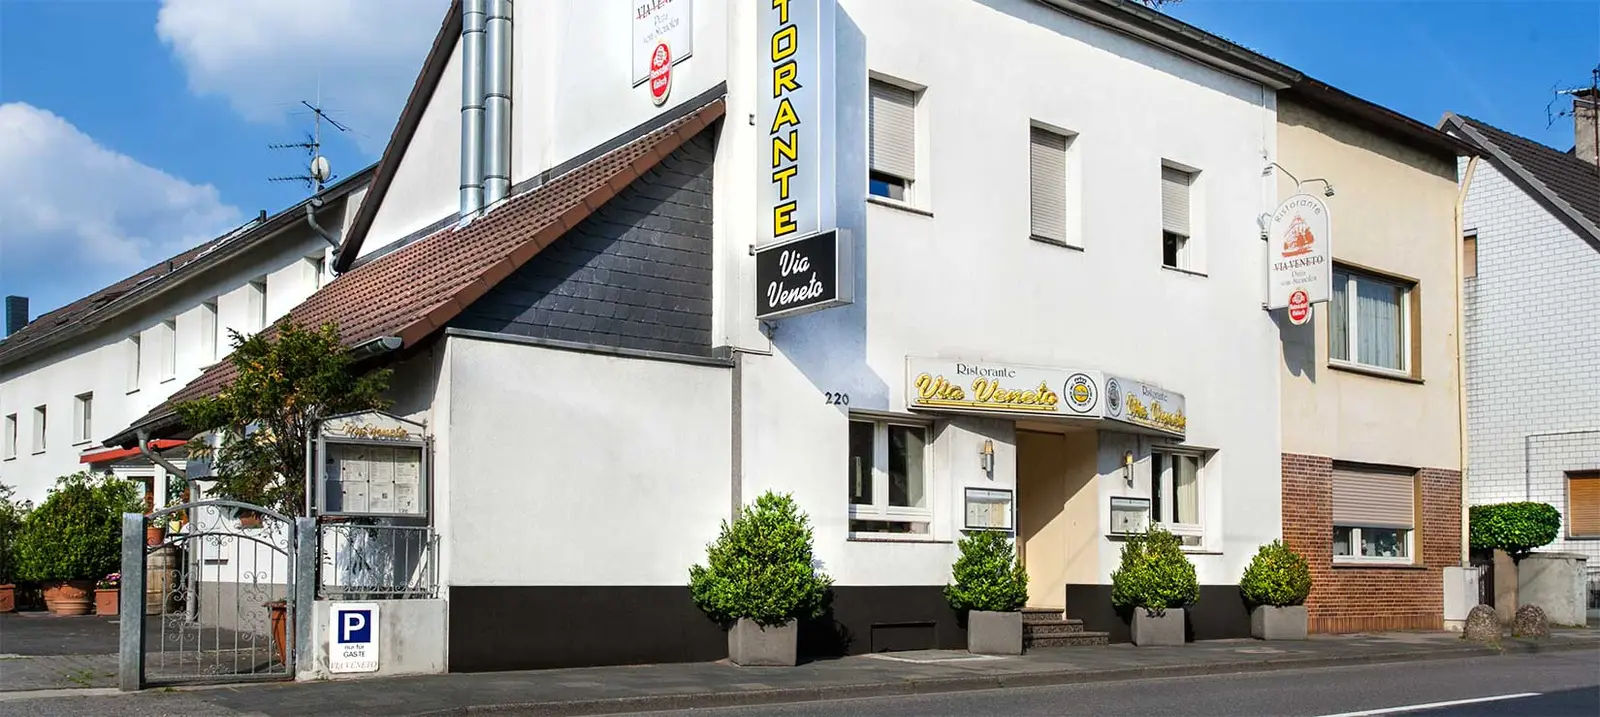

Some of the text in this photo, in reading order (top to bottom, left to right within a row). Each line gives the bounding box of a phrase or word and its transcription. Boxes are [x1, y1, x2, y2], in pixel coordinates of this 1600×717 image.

[1274, 199, 1321, 223] Ristorante
[779, 250, 810, 277] Via
[1273, 255, 1324, 271] VIA VENETO
[767, 272, 823, 307] Veneto
[956, 363, 1016, 378] Ristorante
[825, 391, 849, 406] 220
[915, 372, 965, 400] Via
[971, 376, 1059, 405] Veneto
[344, 613, 365, 641] P
